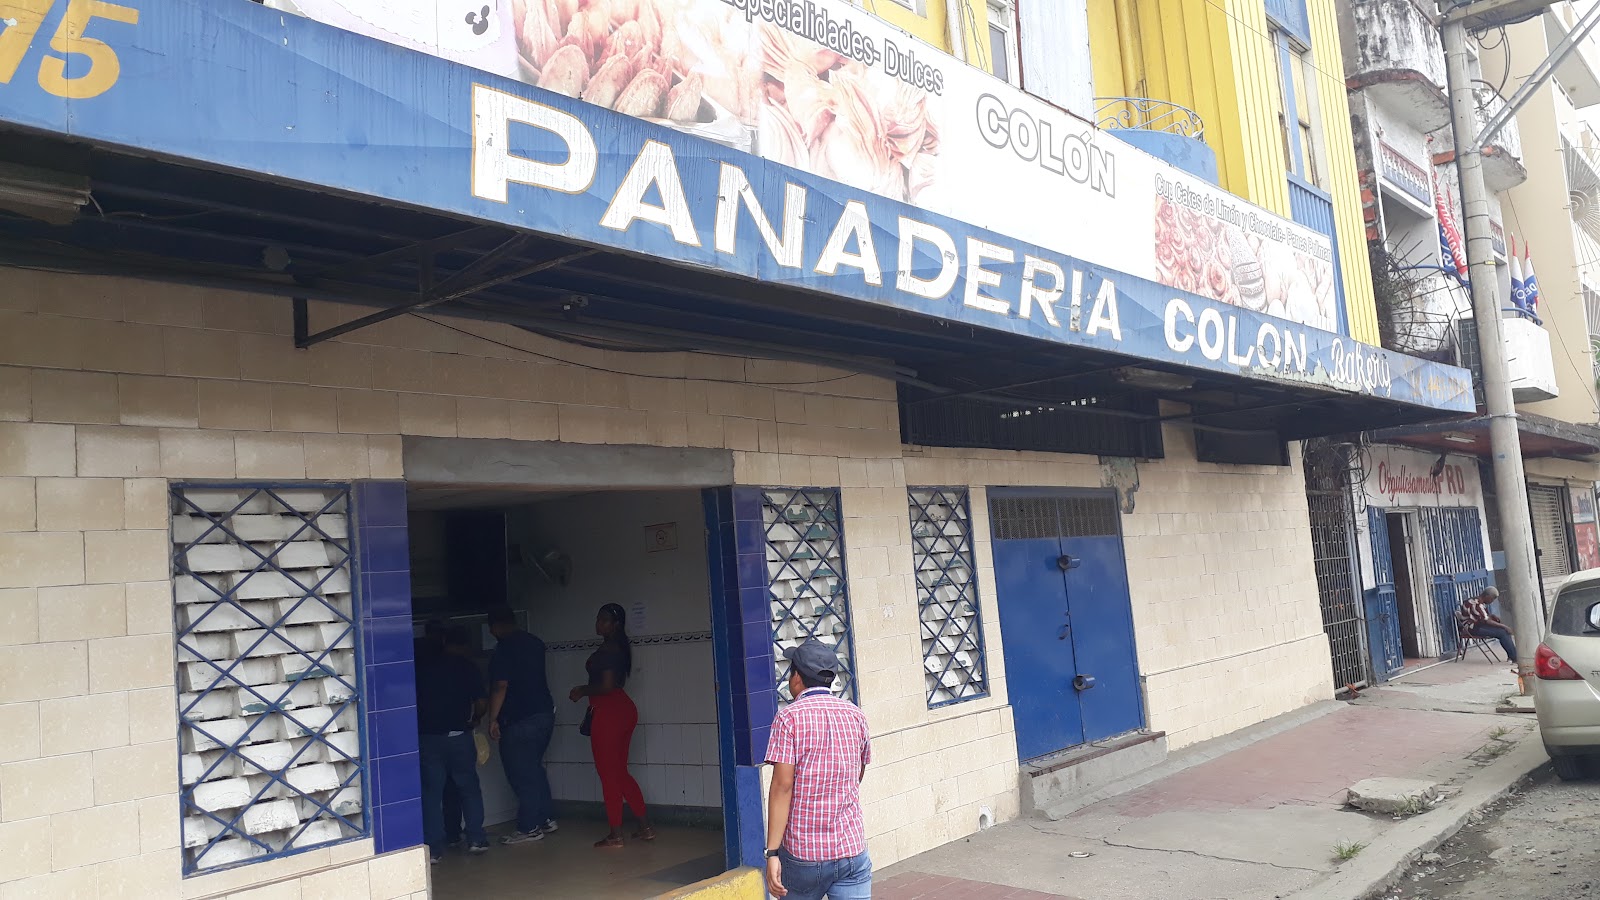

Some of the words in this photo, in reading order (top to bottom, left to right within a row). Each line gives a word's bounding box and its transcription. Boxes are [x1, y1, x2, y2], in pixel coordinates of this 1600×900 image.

[884, 38, 944, 96] Dulces
[976, 93, 1116, 199] COLÓN
[470, 82, 1122, 342] PANADERIA
[1164, 298, 1307, 374] COLON
[1155, 172, 1174, 204] Cup
[1174, 181, 1202, 212] Cakes
[1203, 193, 1215, 217] de
[1216, 197, 1241, 228] Limón
[1241, 212, 1248, 233] y
[1285, 226, 1307, 253] Panes
